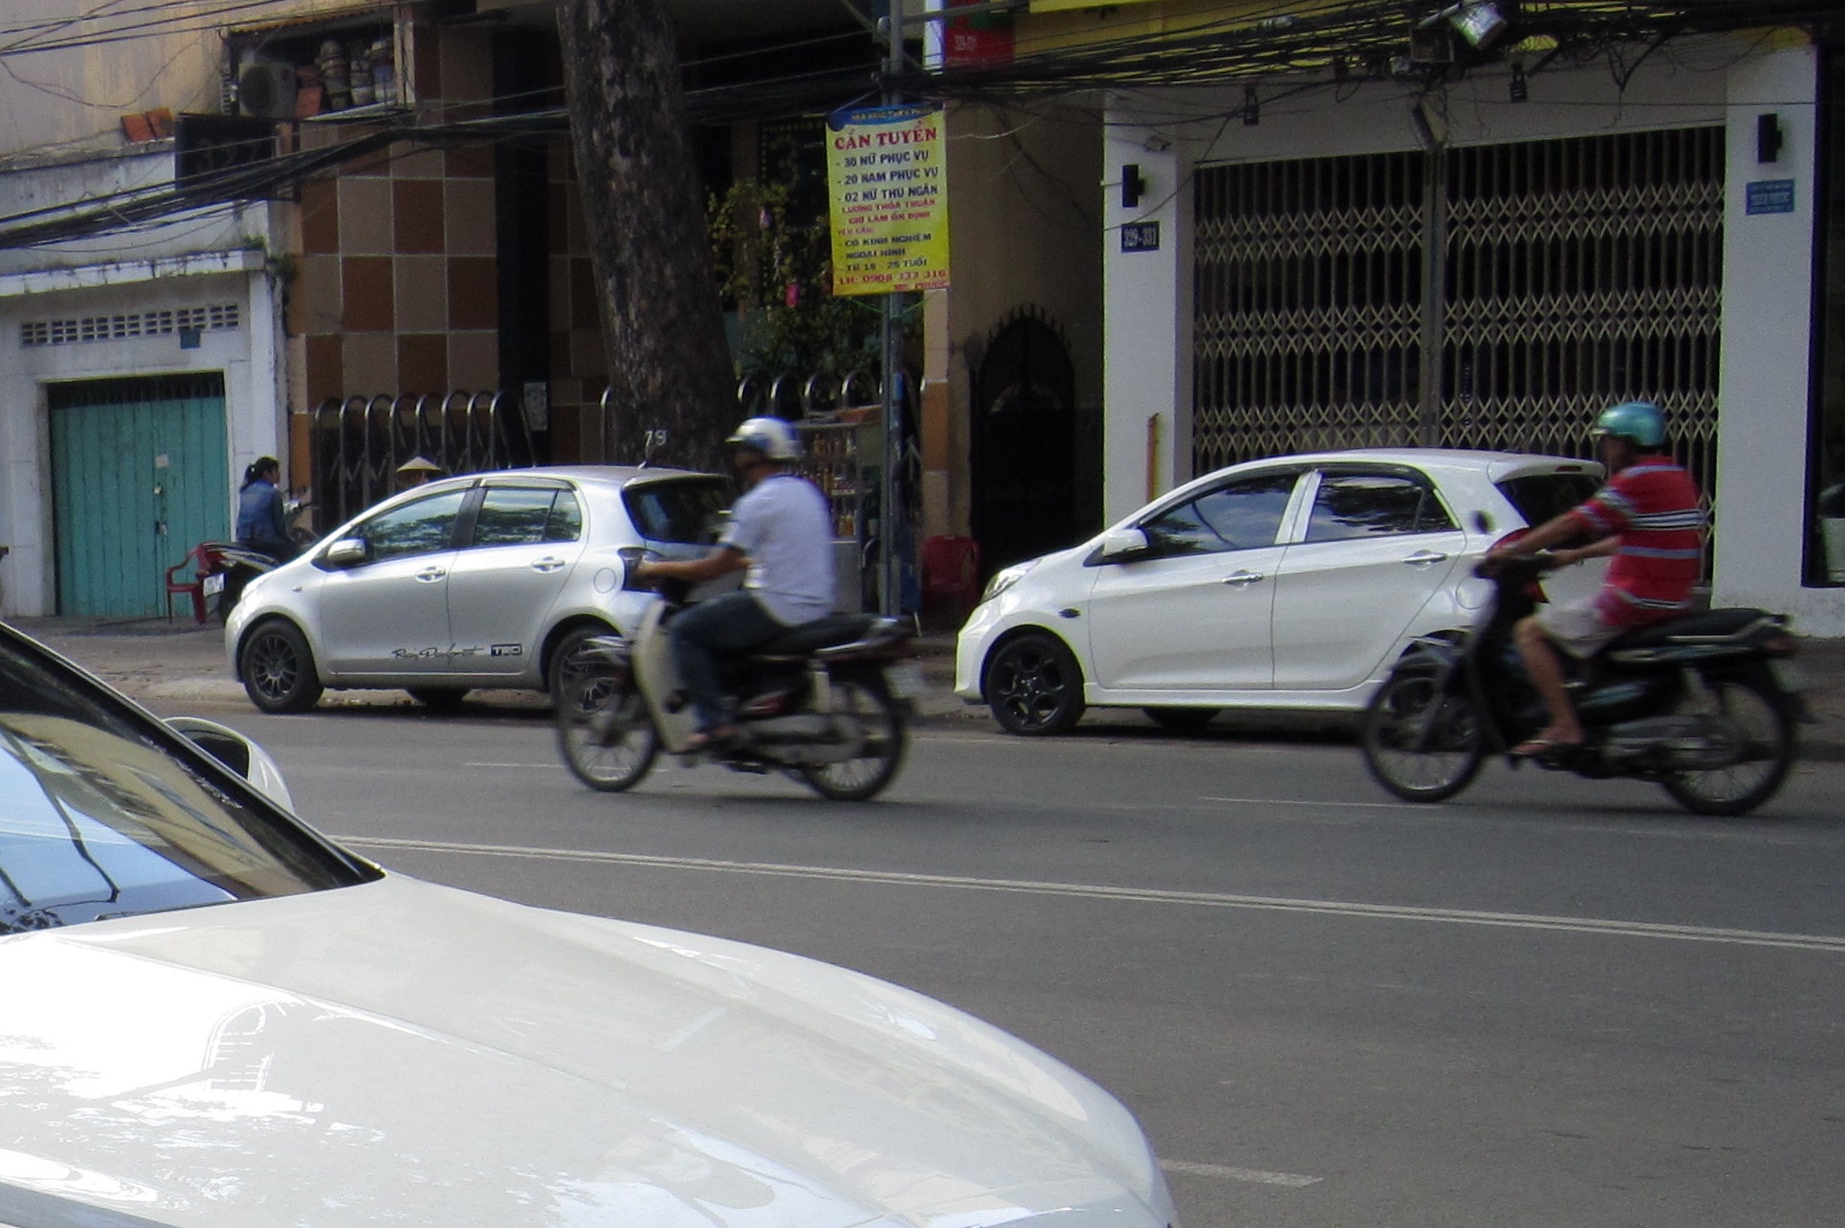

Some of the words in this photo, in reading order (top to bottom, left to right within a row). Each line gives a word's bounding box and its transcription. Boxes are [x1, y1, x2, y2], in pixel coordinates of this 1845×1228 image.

[844, 174, 858, 185] 20
[861, 171, 886, 183] NAM
[844, 192, 858, 202] 02
[882, 188, 904, 200] THU
